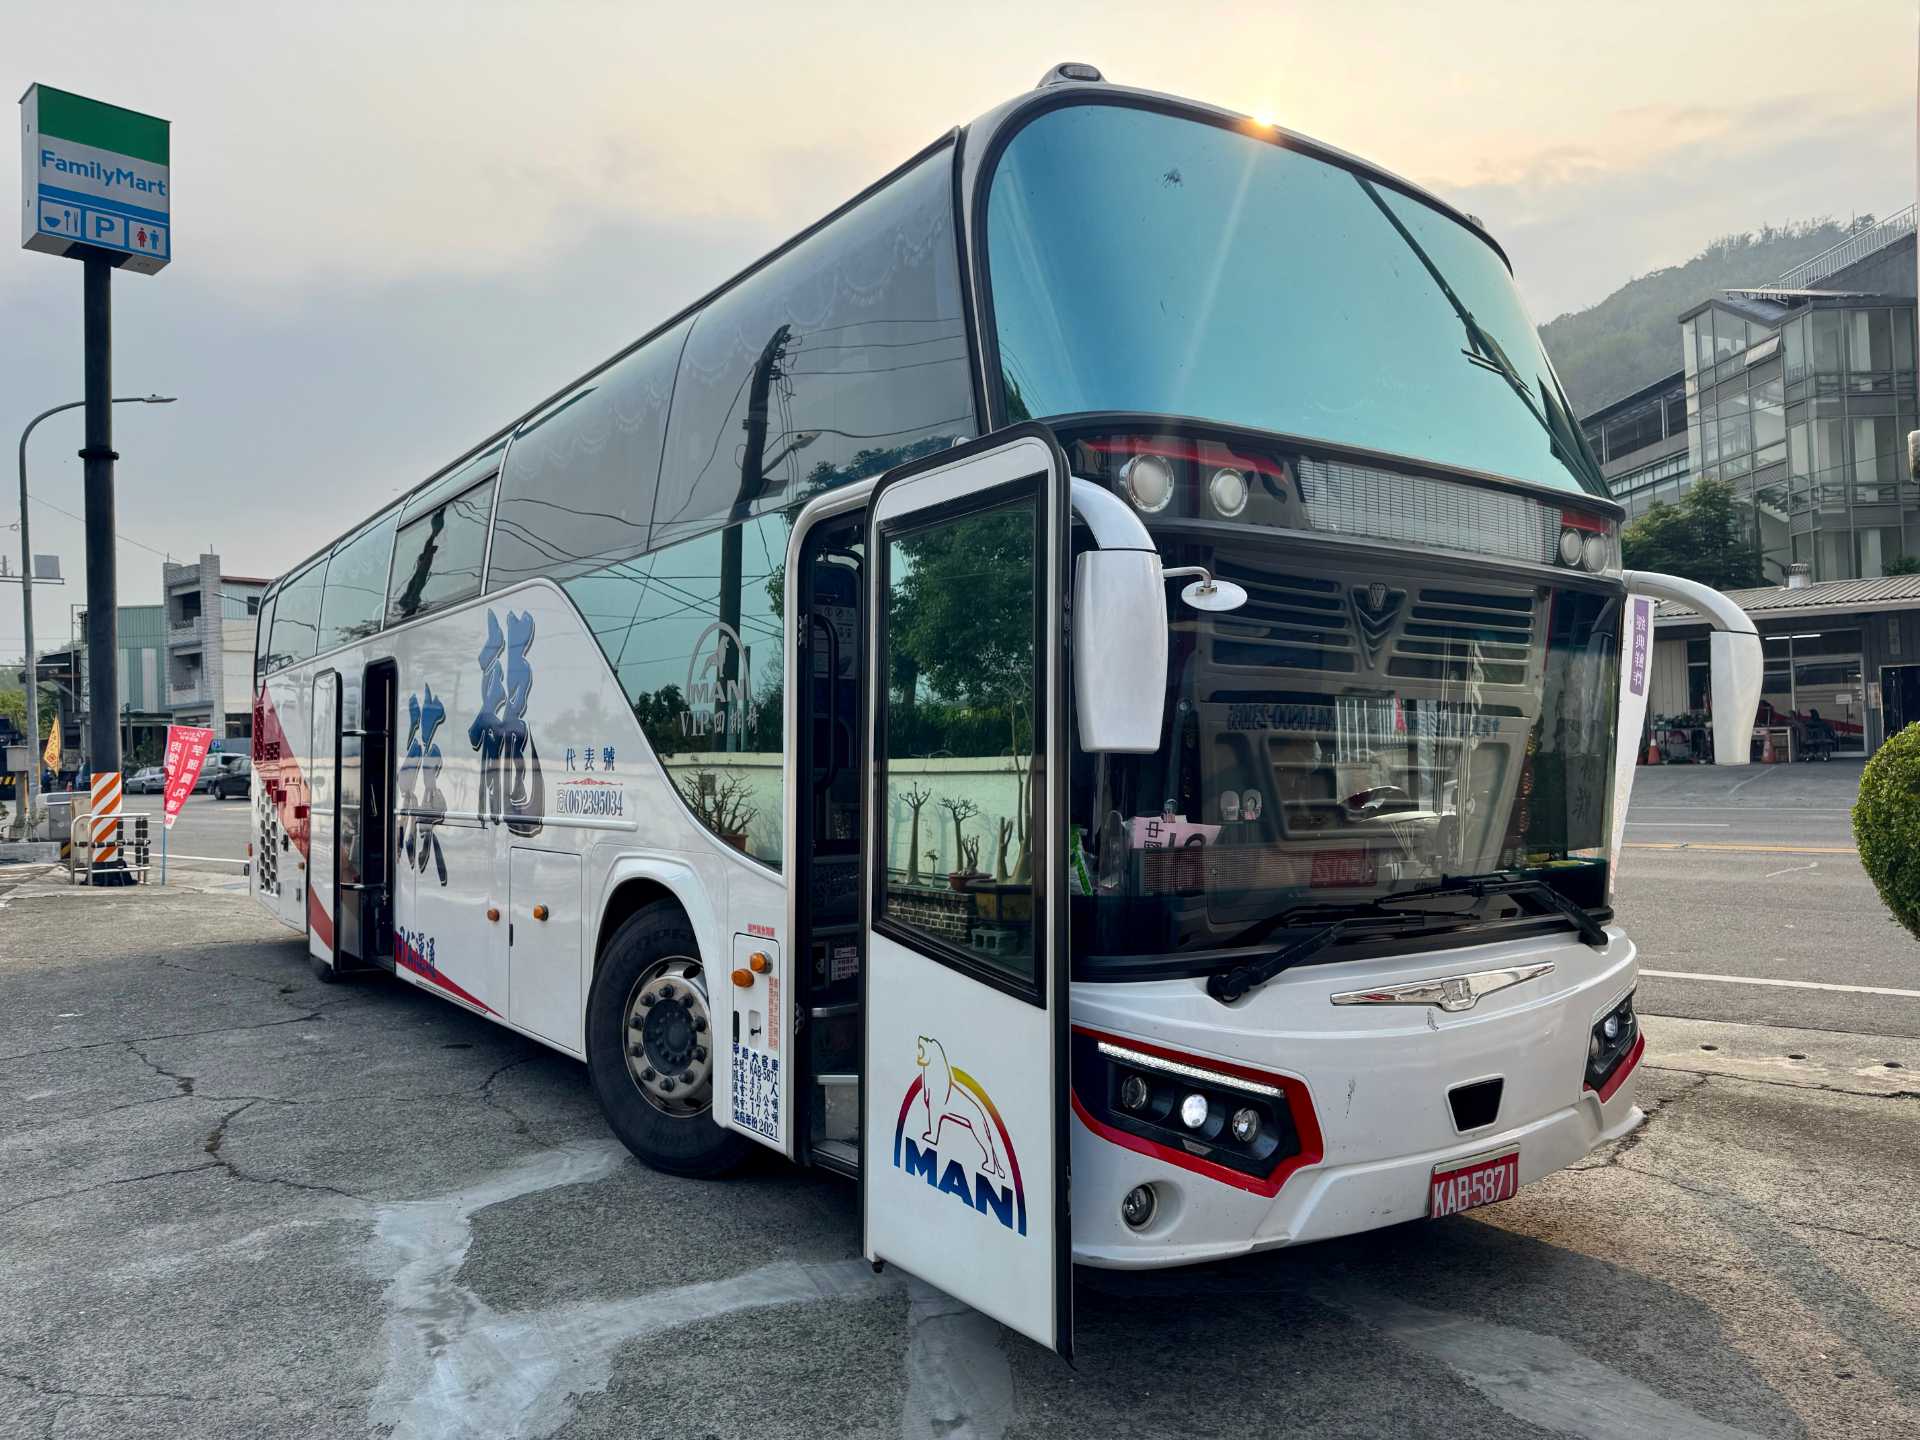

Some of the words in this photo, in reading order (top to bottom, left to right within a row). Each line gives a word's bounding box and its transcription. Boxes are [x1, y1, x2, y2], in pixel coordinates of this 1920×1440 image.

[41, 149, 166, 196] FamilyMart
[95, 216, 115, 238] P
[690, 680, 746, 704] MAN
[680, 710, 710, 737] VIP
[566, 745, 617, 772] 代表號
[905, 1136, 1013, 1230] MAN
[1432, 1163, 1515, 1219] KAB-5871
